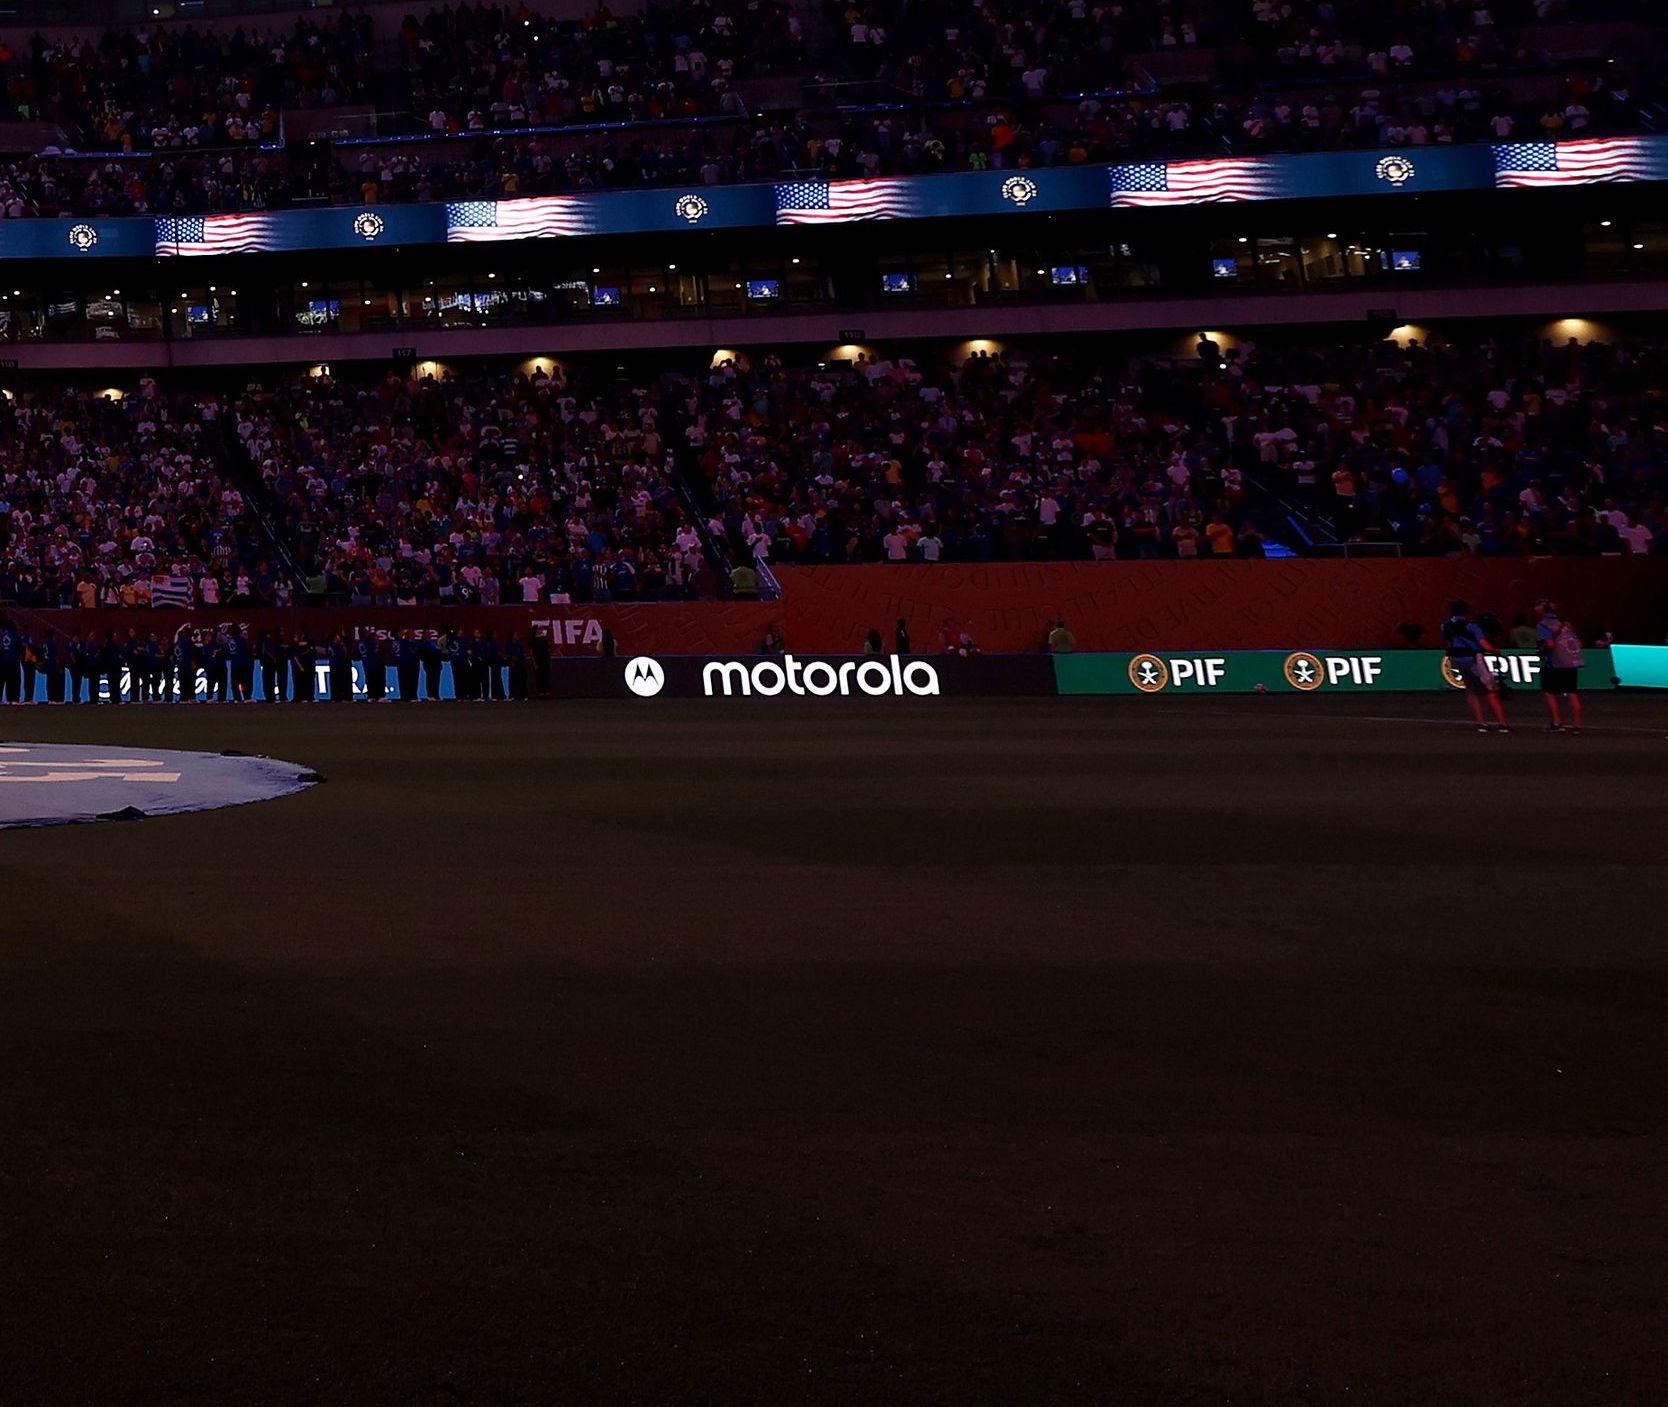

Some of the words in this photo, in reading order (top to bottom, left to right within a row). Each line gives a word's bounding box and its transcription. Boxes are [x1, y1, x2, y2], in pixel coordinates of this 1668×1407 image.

[702, 654, 941, 696] motorola
[1169, 658, 1224, 685] PIF
[1325, 656, 1382, 685] PIF
[1484, 655, 1541, 683] PIF
